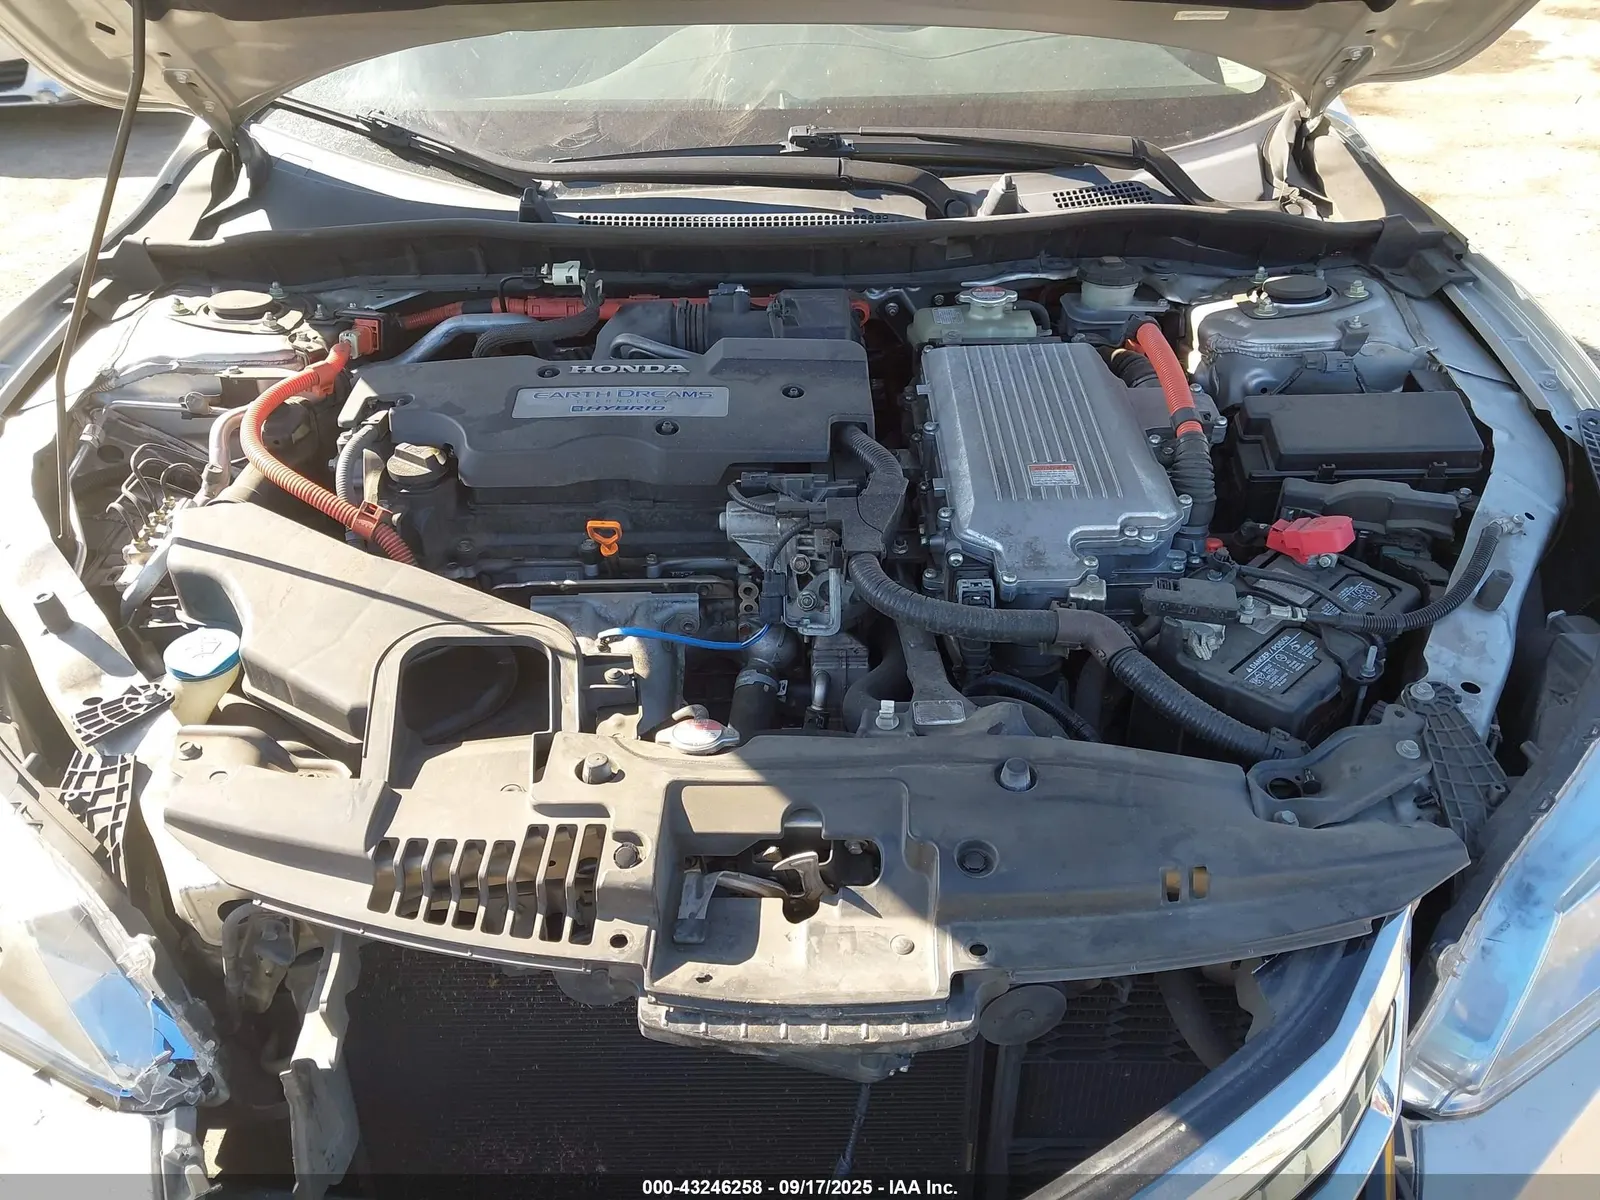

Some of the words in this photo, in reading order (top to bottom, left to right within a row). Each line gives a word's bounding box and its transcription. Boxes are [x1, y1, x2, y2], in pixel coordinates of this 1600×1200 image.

[569, 364, 690, 374] HONDA
[533, 390, 611, 399] EARTH
[616, 389, 714, 399] DREAMS
[1249, 651, 1271, 670] DANGER
[1271, 635, 1292, 651] POISON
